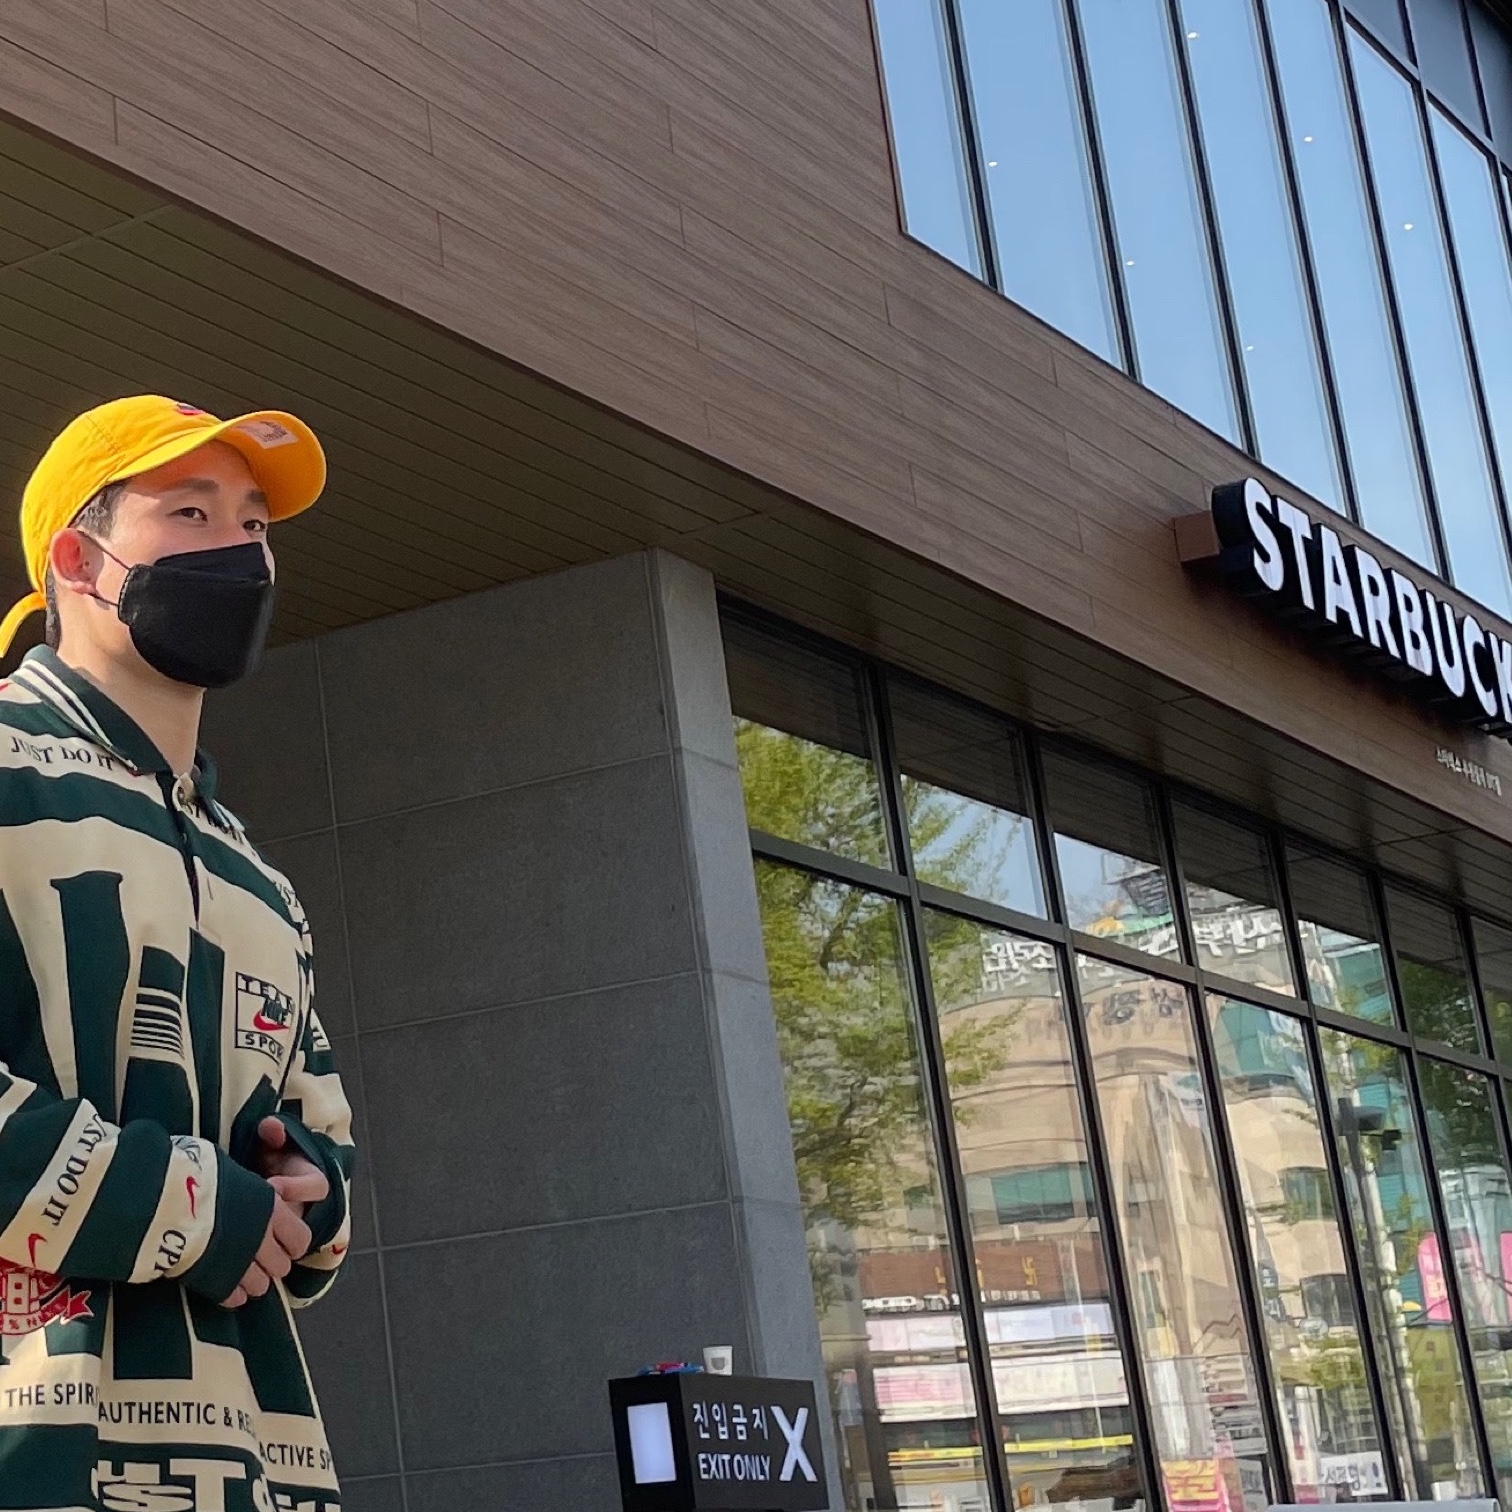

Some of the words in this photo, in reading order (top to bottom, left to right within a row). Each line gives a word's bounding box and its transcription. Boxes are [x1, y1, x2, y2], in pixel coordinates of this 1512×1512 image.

[11, 736, 54, 764] JUST
[59, 745, 92, 764] DO
[96, 753, 114, 771] IT
[57, 1155, 88, 1196] DO
[41, 1194, 70, 1227] IT
[5, 1384, 45, 1408] THE
[98, 1401, 216, 1425] AUTHENTIC
[223, 1406, 233, 1428] &
[259, 1441, 315, 1468] ACTIVE
[692, 1400, 769, 1440] 진입금지
[697, 1453, 731, 1480] EXIT
[733, 1454, 770, 1481] ONLY
